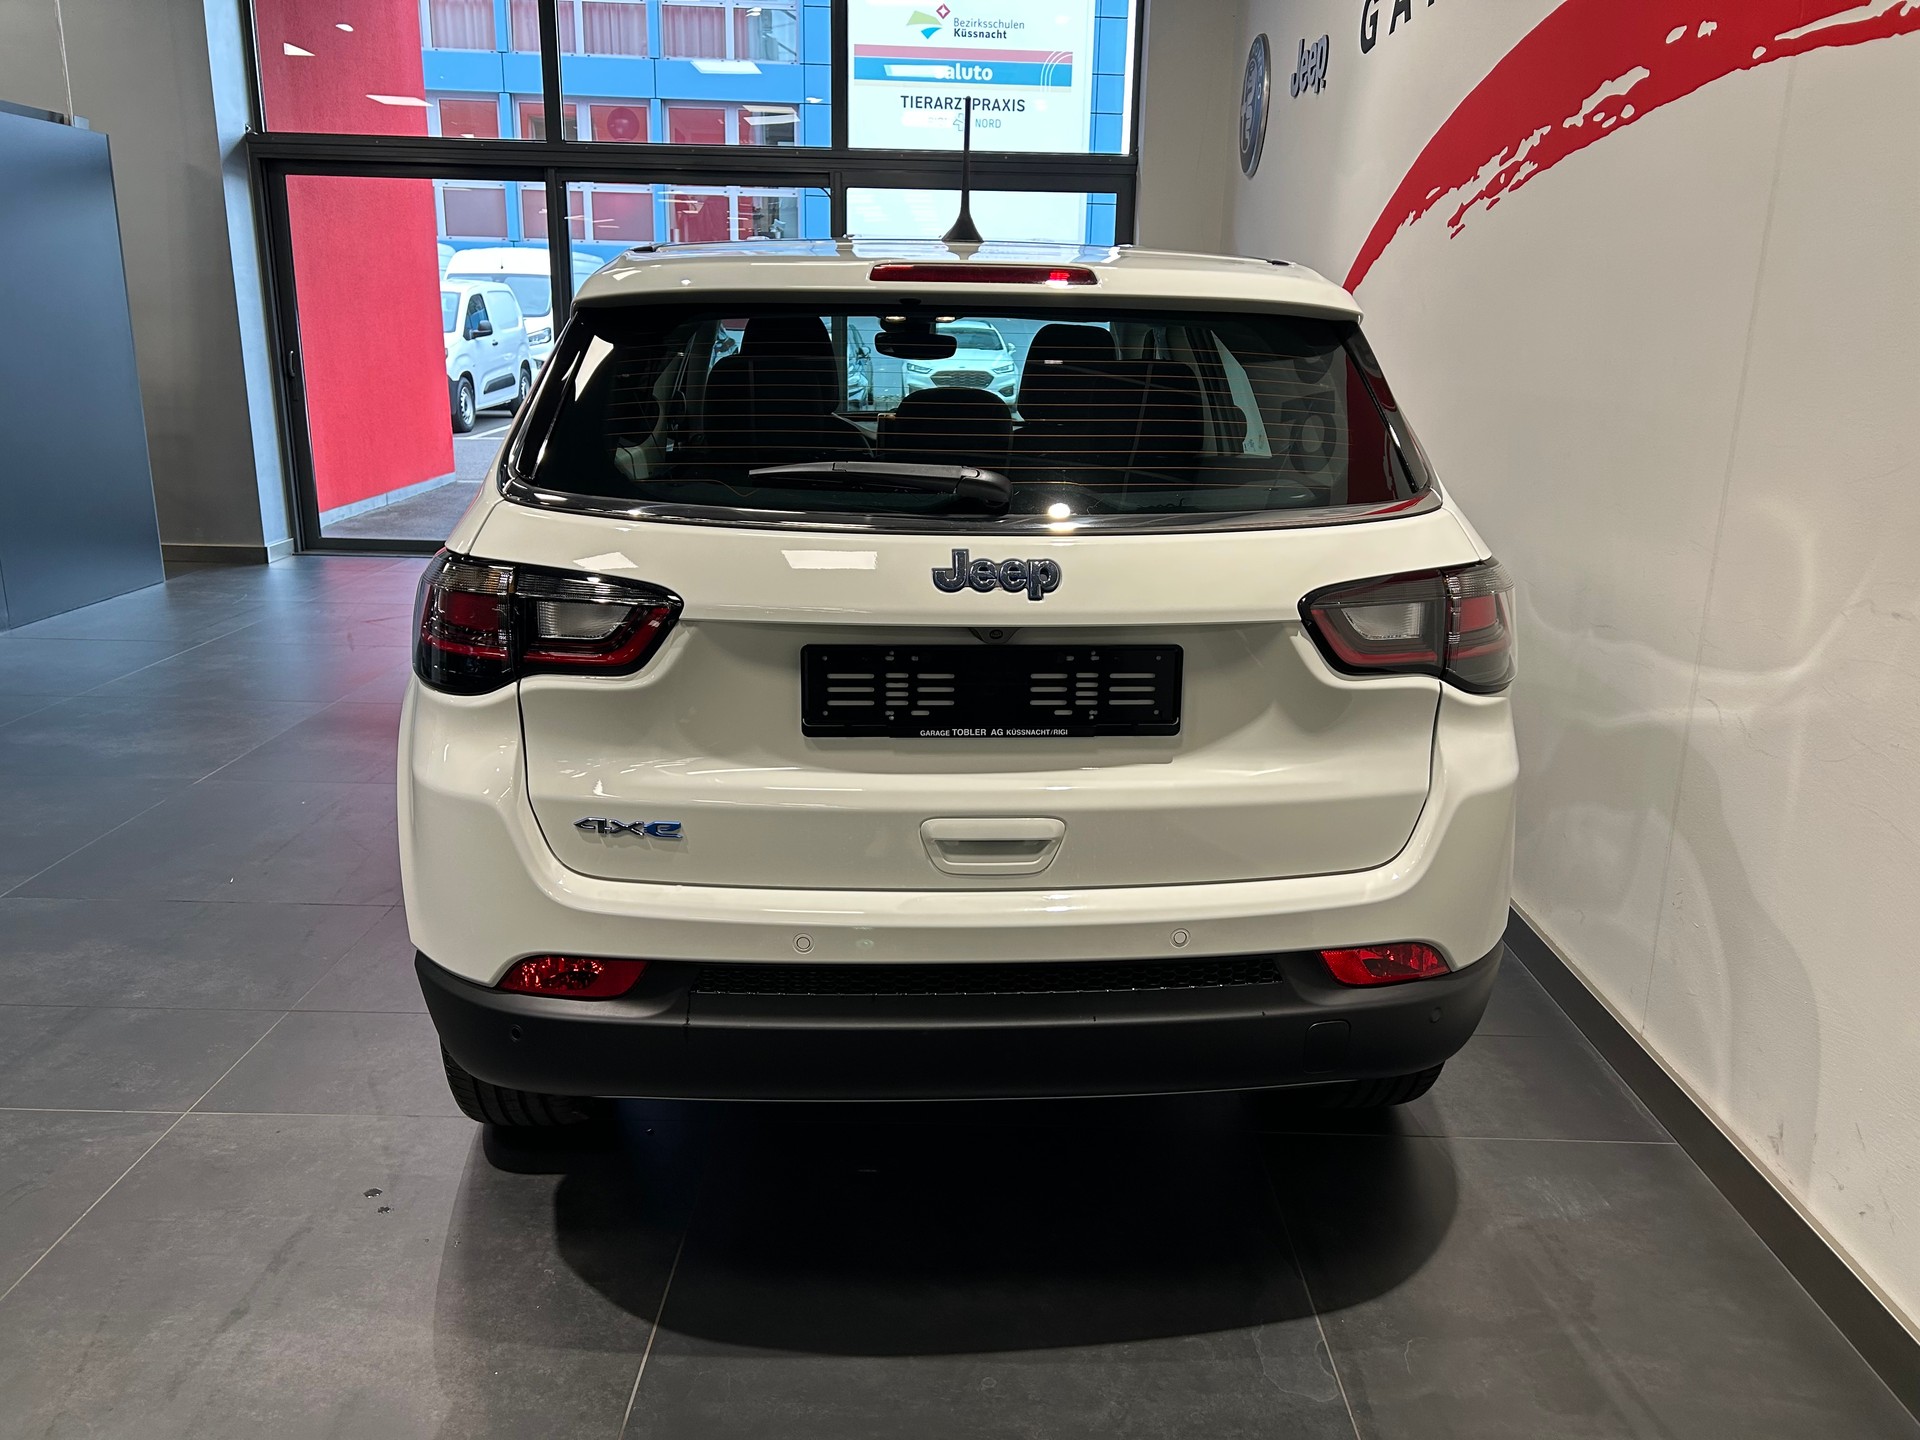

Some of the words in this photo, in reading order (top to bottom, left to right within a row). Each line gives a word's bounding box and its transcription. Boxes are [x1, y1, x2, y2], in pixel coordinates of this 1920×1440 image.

[953, 17, 1025, 29] Bezirksschulen
[1360, 0, 1435, 54] GA
[953, 28, 1007, 39] Küssnacht
[975, 118, 1002, 129] NORD
[932, 549, 1061, 601] Jeep
[952, 728, 987, 736] TOBLER
[990, 728, 1004, 736] AG
[1006, 728, 1068, 736] KÜSSNACHT/RIGI
